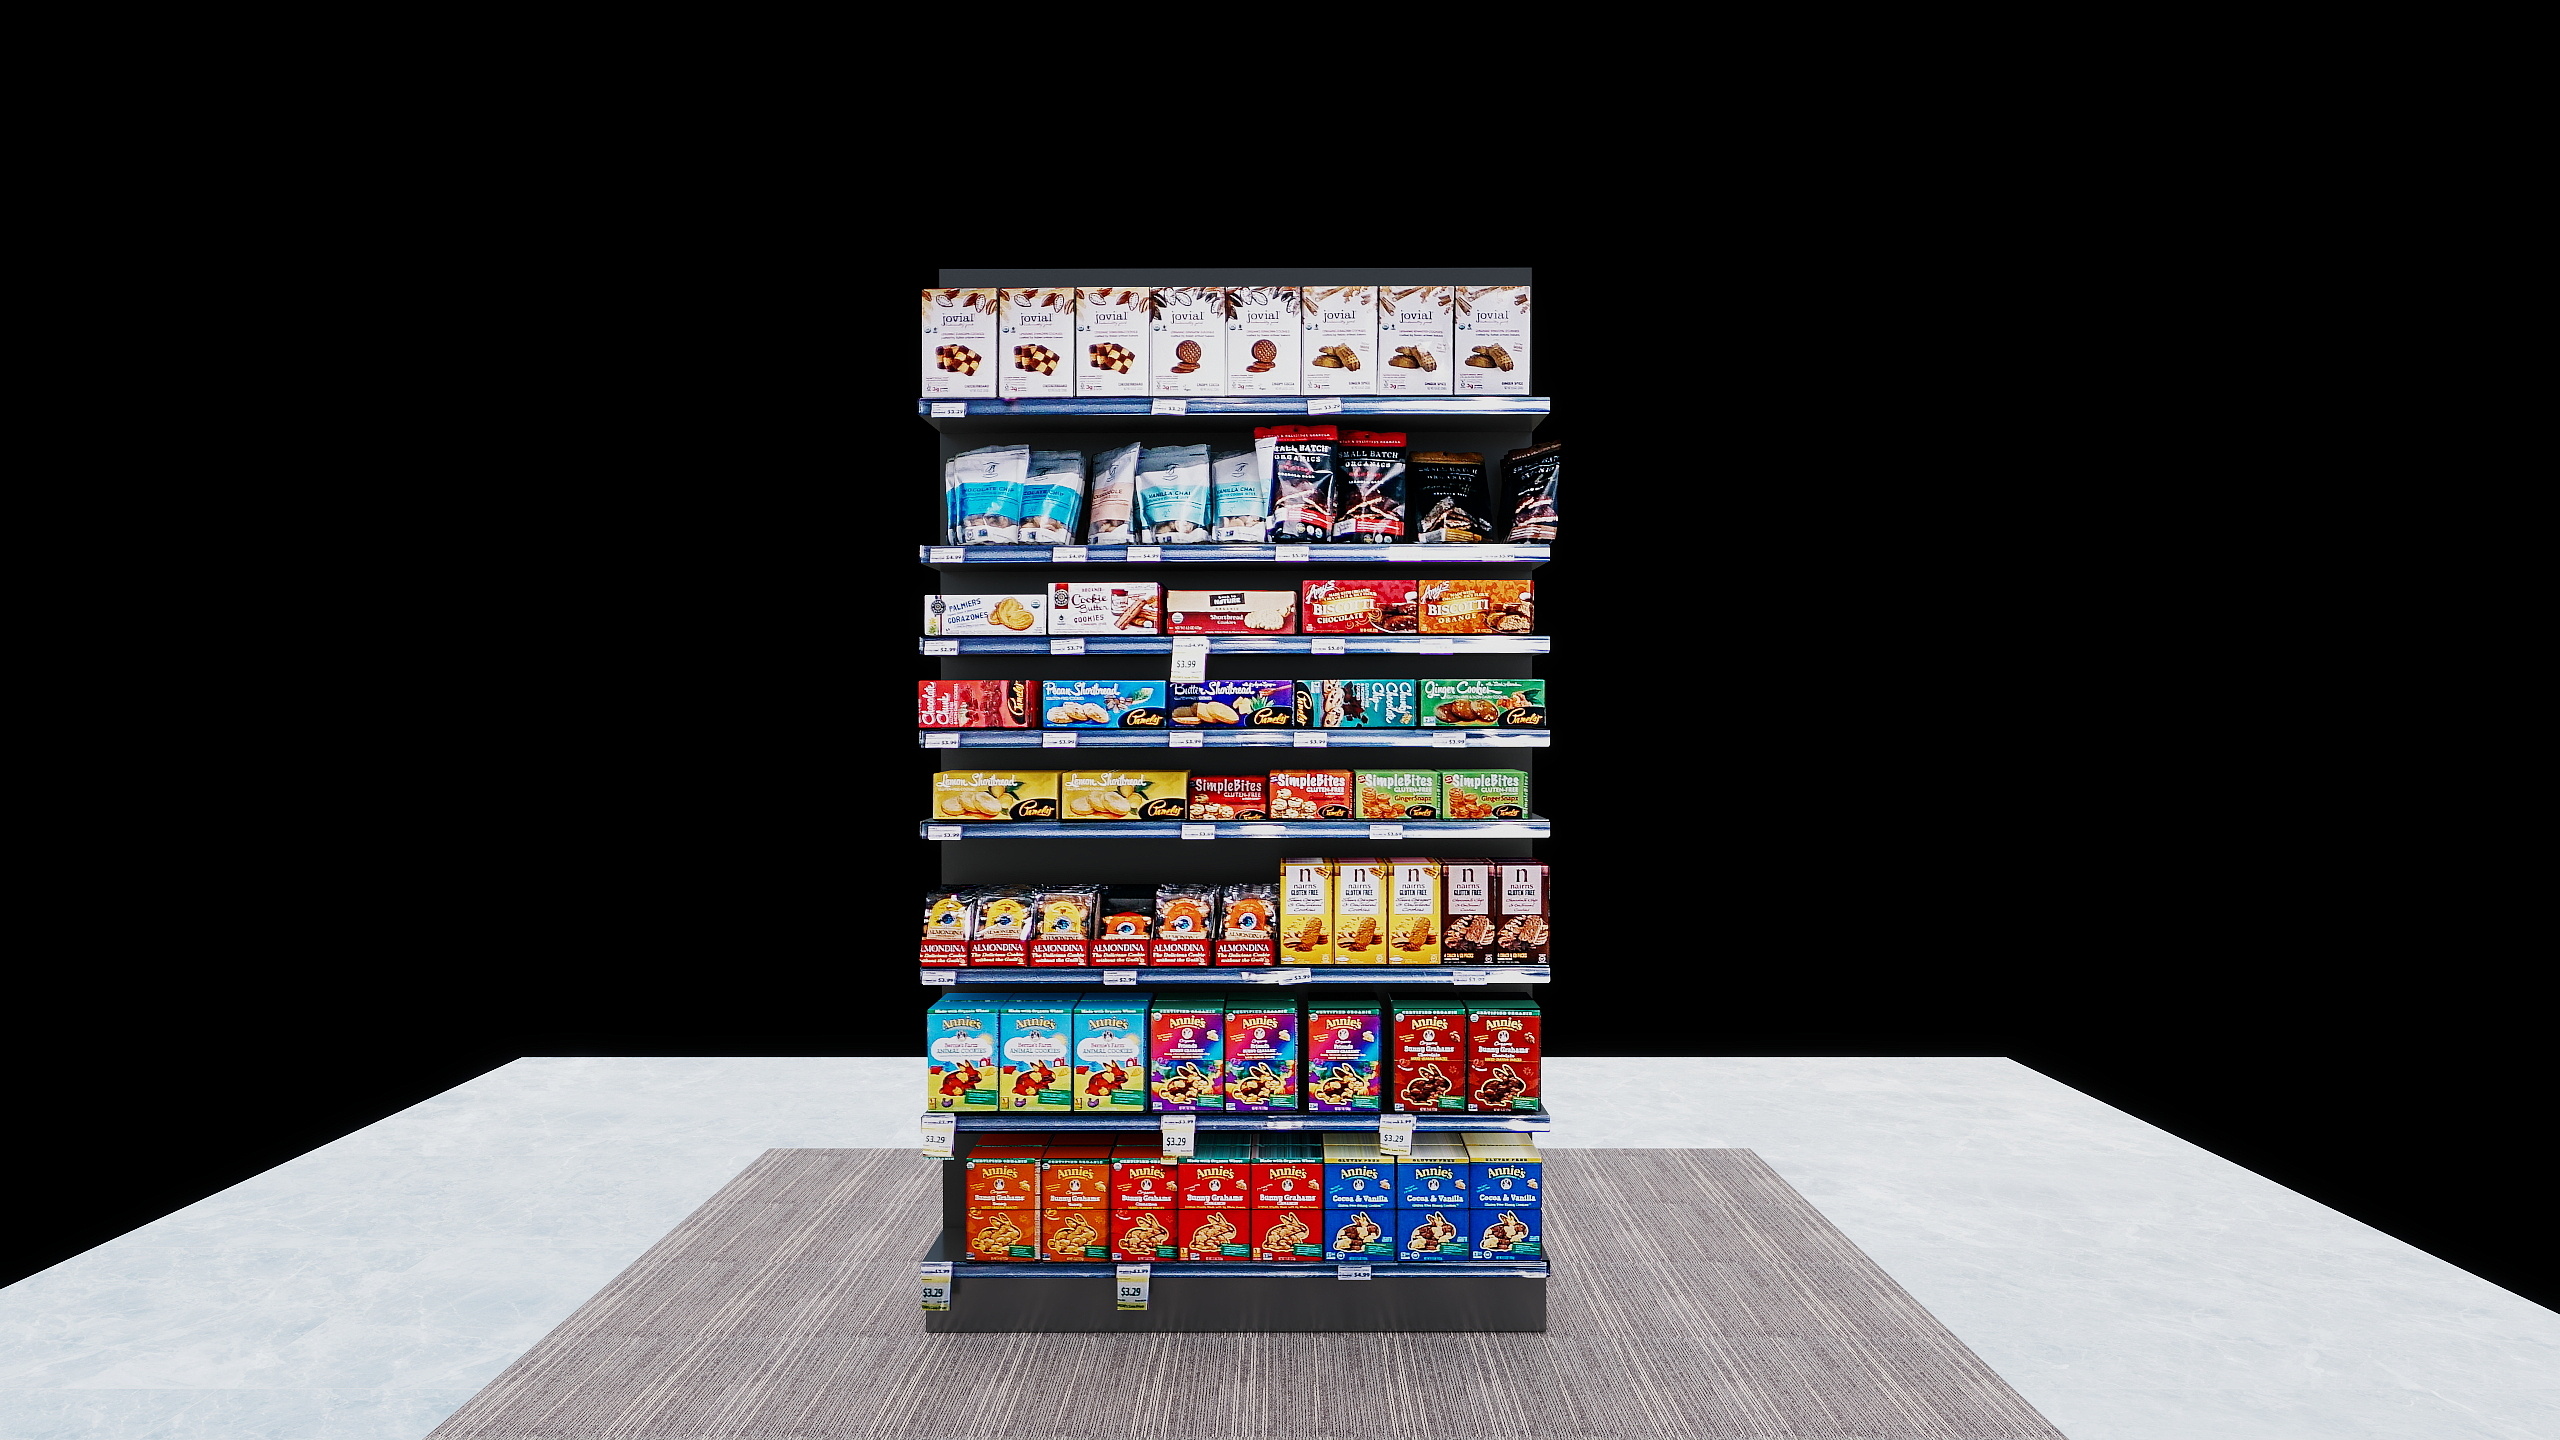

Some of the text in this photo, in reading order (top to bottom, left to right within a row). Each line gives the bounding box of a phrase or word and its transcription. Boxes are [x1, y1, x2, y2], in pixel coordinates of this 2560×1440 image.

[941, 312, 974, 326] jovial
[1019, 312, 1052, 326] jovial
[1095, 311, 1128, 325] jovial
[1171, 310, 1204, 324] jovial
[1247, 310, 1279, 324] jovial
[1323, 310, 1356, 324] jovial
[1400, 310, 1432, 324] jovial
[1476, 310, 1509, 324] jovial
[1299, 444, 1330, 453] BATCH
[1338, 450, 1398, 459] SMALL BATCH
[1274, 454, 1321, 463] ORGANICS
[1148, 490, 1174, 498] VANILLA
[1304, 580, 1335, 604] Amy's
[1421, 581, 1450, 604] Amy's
[949, 598, 981, 612] PALMIERS
[1072, 593, 1107, 606] Cookie
[1313, 599, 1375, 615] BISCOTTI
[1428, 599, 1489, 616] BISCOTTI
[947, 612, 988, 624] CORAZONES
[1073, 614, 1104, 623] COOKIES
[1317, 612, 1364, 624] CHOCOLATE
[1438, 613, 1477, 623] ORANGE
[1176, 660, 1196, 668] $3.99
[1043, 682, 1120, 695] Pecan Shortbread
[1170, 683, 1206, 695] Butter
[1206, 682, 1255, 695] Shortbread
[1425, 681, 1502, 699] Ginger Cookies
[921, 681, 936, 724] Chocolate
[1385, 682, 1399, 724] Chocolate
[1127, 709, 1163, 725] Pamela's
[1254, 708, 1289, 725] Pamela's
[1507, 708, 1543, 725] Pamela's
[936, 773, 1017, 787] Lemon Shortbread
[1065, 773, 1146, 787] Lemon Shortbread
[1195, 779, 1262, 794] SimpleBites
[1278, 773, 1345, 789] SimpleBites
[1365, 773, 1432, 789] SimpleBites
[1452, 774, 1519, 789] SimpleBites
[1019, 800, 1055, 817] Pamela's
[1148, 800, 1184, 817] Pamela's
[1299, 868, 1311, 882] n
[1354, 868, 1366, 882] n
[1408, 868, 1420, 882] n
[1462, 868, 1474, 882] n
[1516, 868, 1528, 882] n
[920, 944, 965, 952] LMONDINA
[972, 944, 1023, 952] ALMONDINA
[1033, 944, 1084, 952] ALMONDINA
[1093, 944, 1144, 952] ALMONDINA
[1153, 944, 1204, 952] ALMONDINA
[1218, 944, 1269, 952] ALMONDINA
[942, 1016, 982, 1030] Annie's
[1016, 1016, 1056, 1030] Annie's
[1088, 1016, 1128, 1030] Annie's
[1169, 1015, 1206, 1029] Annie's
[1242, 1015, 1278, 1029] Annie's
[1326, 1016, 1362, 1030] Annie's
[1412, 1016, 1448, 1030] Annie's
[1486, 1017, 1523, 1031] Annie's
[925, 1136, 945, 1144] $3.29
[1166, 1137, 1186, 1146] $3.29
[982, 1166, 1018, 1179] Annie's
[1057, 1167, 1094, 1180] Annie's
[1129, 1166, 1166, 1180] Annie's
[1197, 1166, 1234, 1179] Annie's
[1269, 1166, 1307, 1179] Annie's
[1341, 1166, 1378, 1179] Annie's
[1416, 1166, 1453, 1179] Annie's
[1488, 1165, 1526, 1179] Annie's
[1187, 1194, 1210, 1202] Bunny
[1260, 1194, 1283, 1202] Bunny
[1480, 1194, 1536, 1202] Cocoa & Vanilla
[923, 1288, 943, 1297] $3.29
[1121, 1288, 1141, 1297] $3.29
